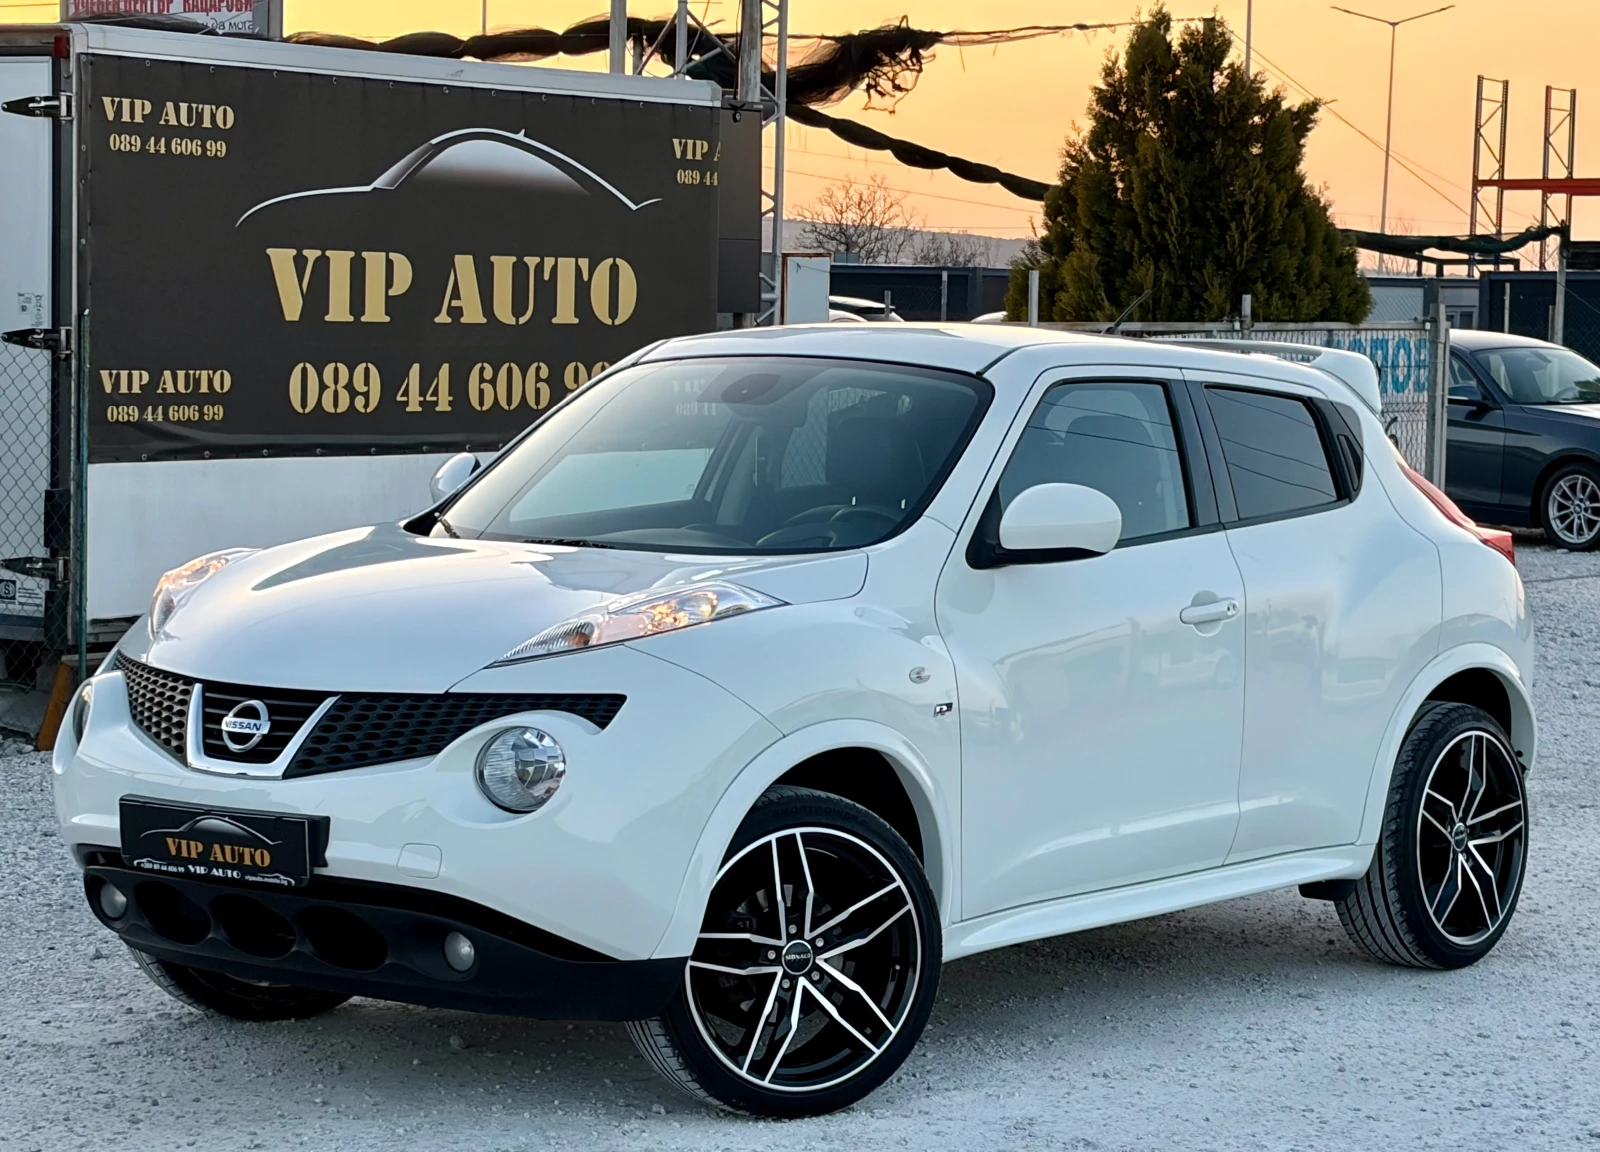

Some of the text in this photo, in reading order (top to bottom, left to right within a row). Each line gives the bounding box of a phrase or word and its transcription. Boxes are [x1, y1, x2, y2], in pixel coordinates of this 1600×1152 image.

[101, 96, 235, 129] VIP AUTO
[109, 133, 227, 157] 089 44 606 99
[672, 138, 709, 160] VIP
[676, 169, 700, 185] 089
[266, 248, 638, 326] VIP AUTO
[99, 369, 232, 394] VIP AUTO
[288, 362, 382, 414] 089
[396, 363, 453, 412] 44
[468, 362, 550, 411] 606
[106, 404, 224, 422] 089 44 606 99
[225, 720, 262, 731] NISSAN
[165, 837, 271, 867] VIP AUTO
[187, 864, 208, 875] VIP
[210, 867, 242, 879] AUTO
